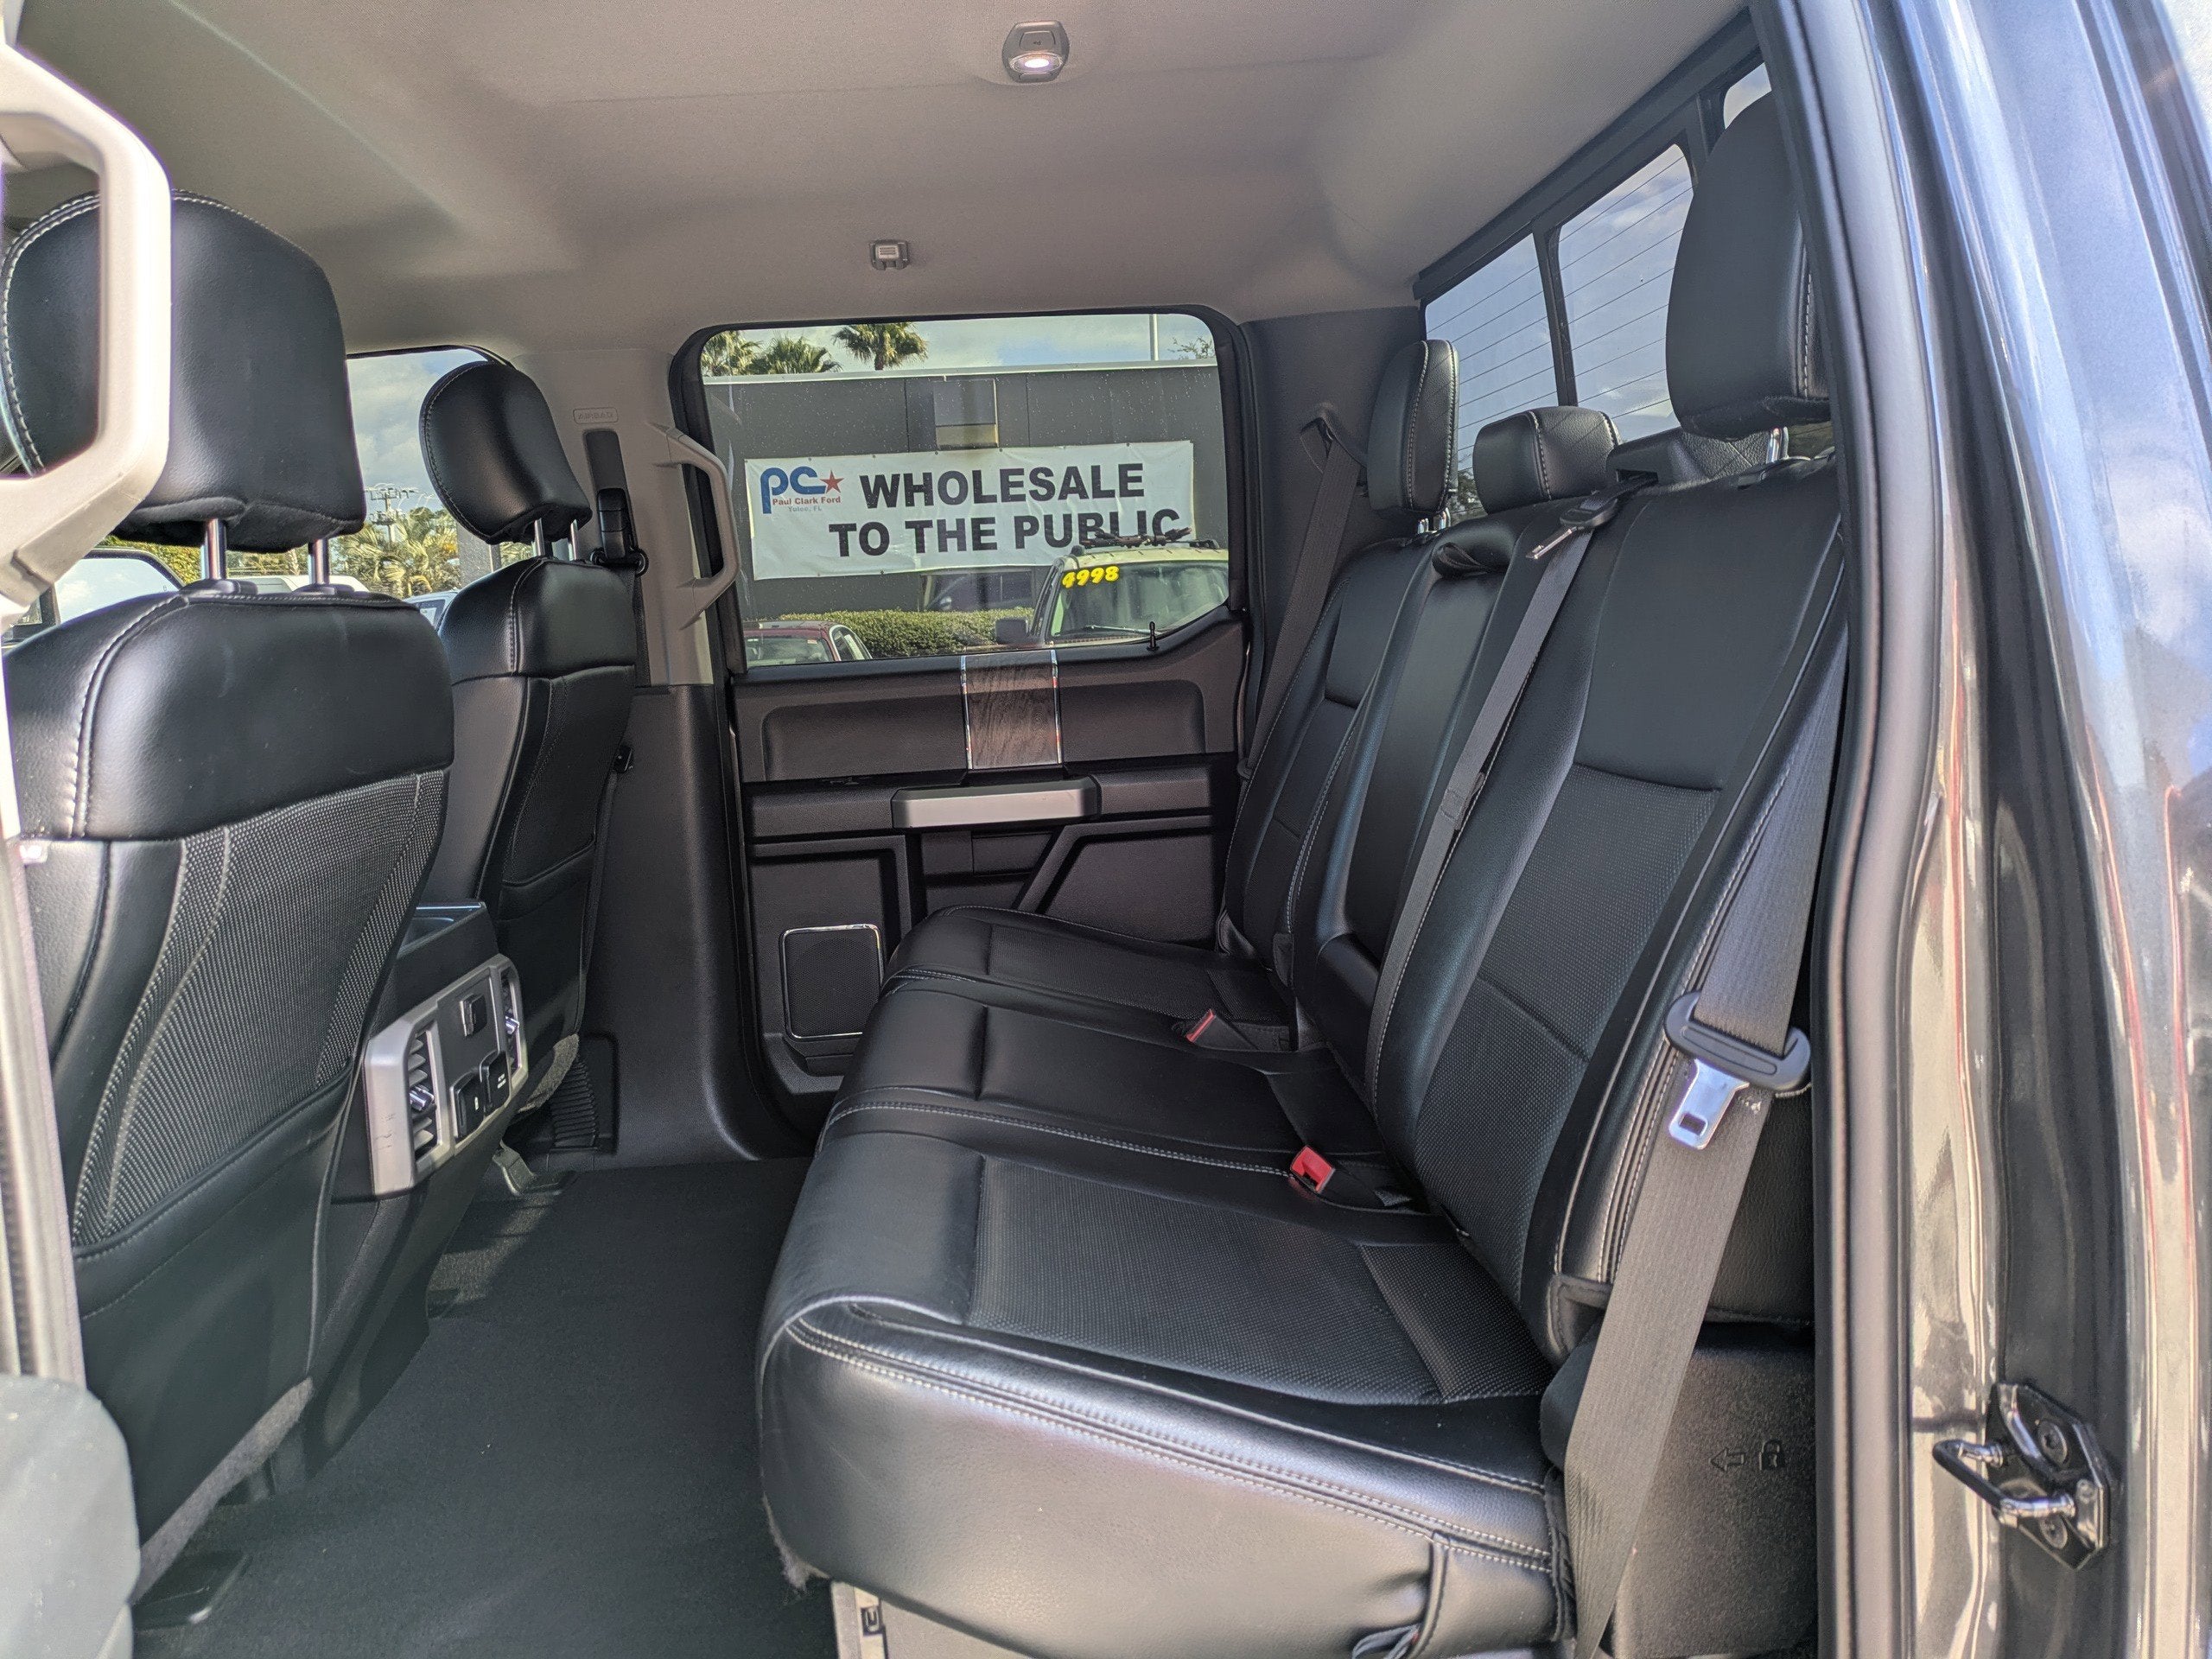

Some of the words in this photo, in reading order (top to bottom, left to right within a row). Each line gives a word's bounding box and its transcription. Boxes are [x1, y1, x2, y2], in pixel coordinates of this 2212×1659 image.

[859, 463, 1144, 509] WHOLESALE
[829, 520, 890, 557] TO
[905, 518, 998, 554] THE
[1062, 565, 1120, 589] 4998
